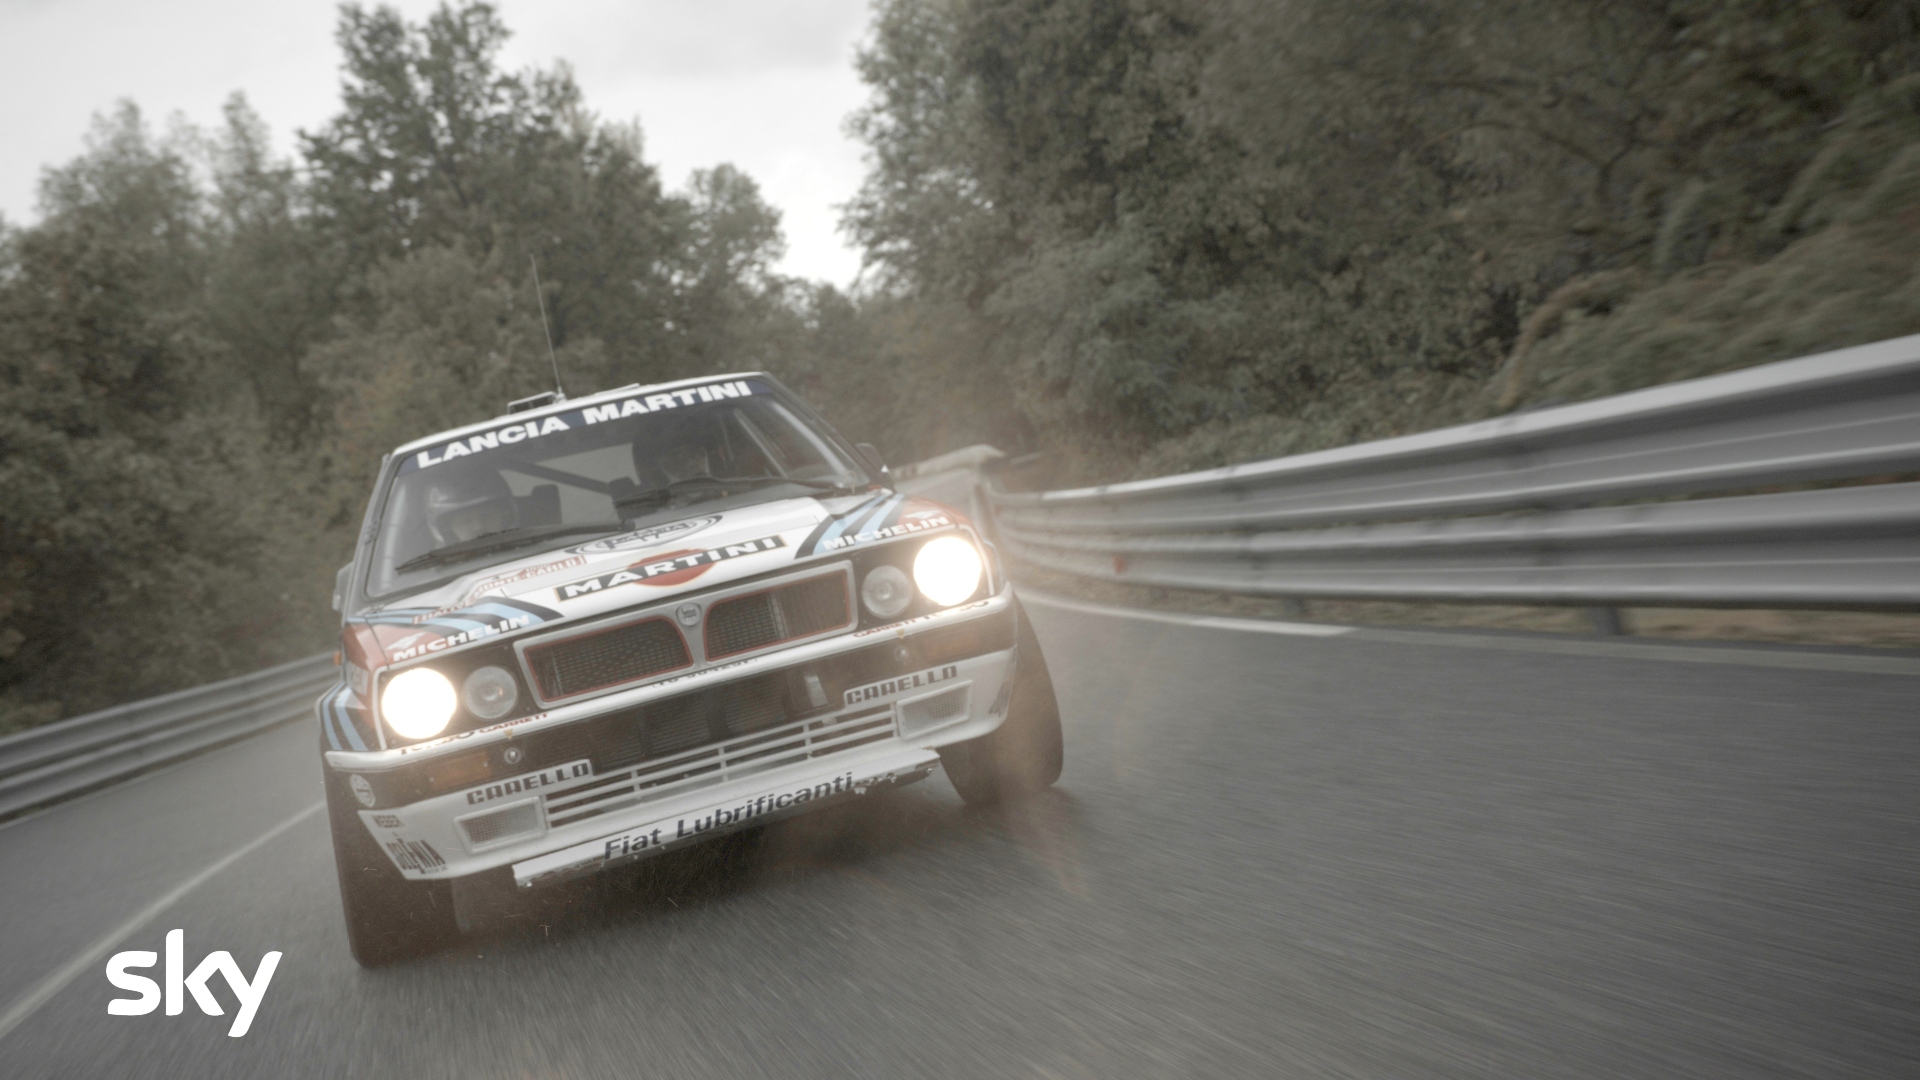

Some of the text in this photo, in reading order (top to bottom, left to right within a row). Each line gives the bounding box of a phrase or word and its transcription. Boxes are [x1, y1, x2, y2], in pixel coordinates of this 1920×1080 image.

[417, 381, 752, 468] LANCIA MARTINI
[822, 516, 949, 550] MICHELIN
[563, 537, 778, 598] MARTINI
[393, 615, 530, 661] MICHELIN
[846, 665, 957, 705] CARELLO
[479, 713, 548, 734] GARRETT
[466, 762, 589, 805] CARELLO
[604, 772, 853, 860] Fiat Lubrificanti
